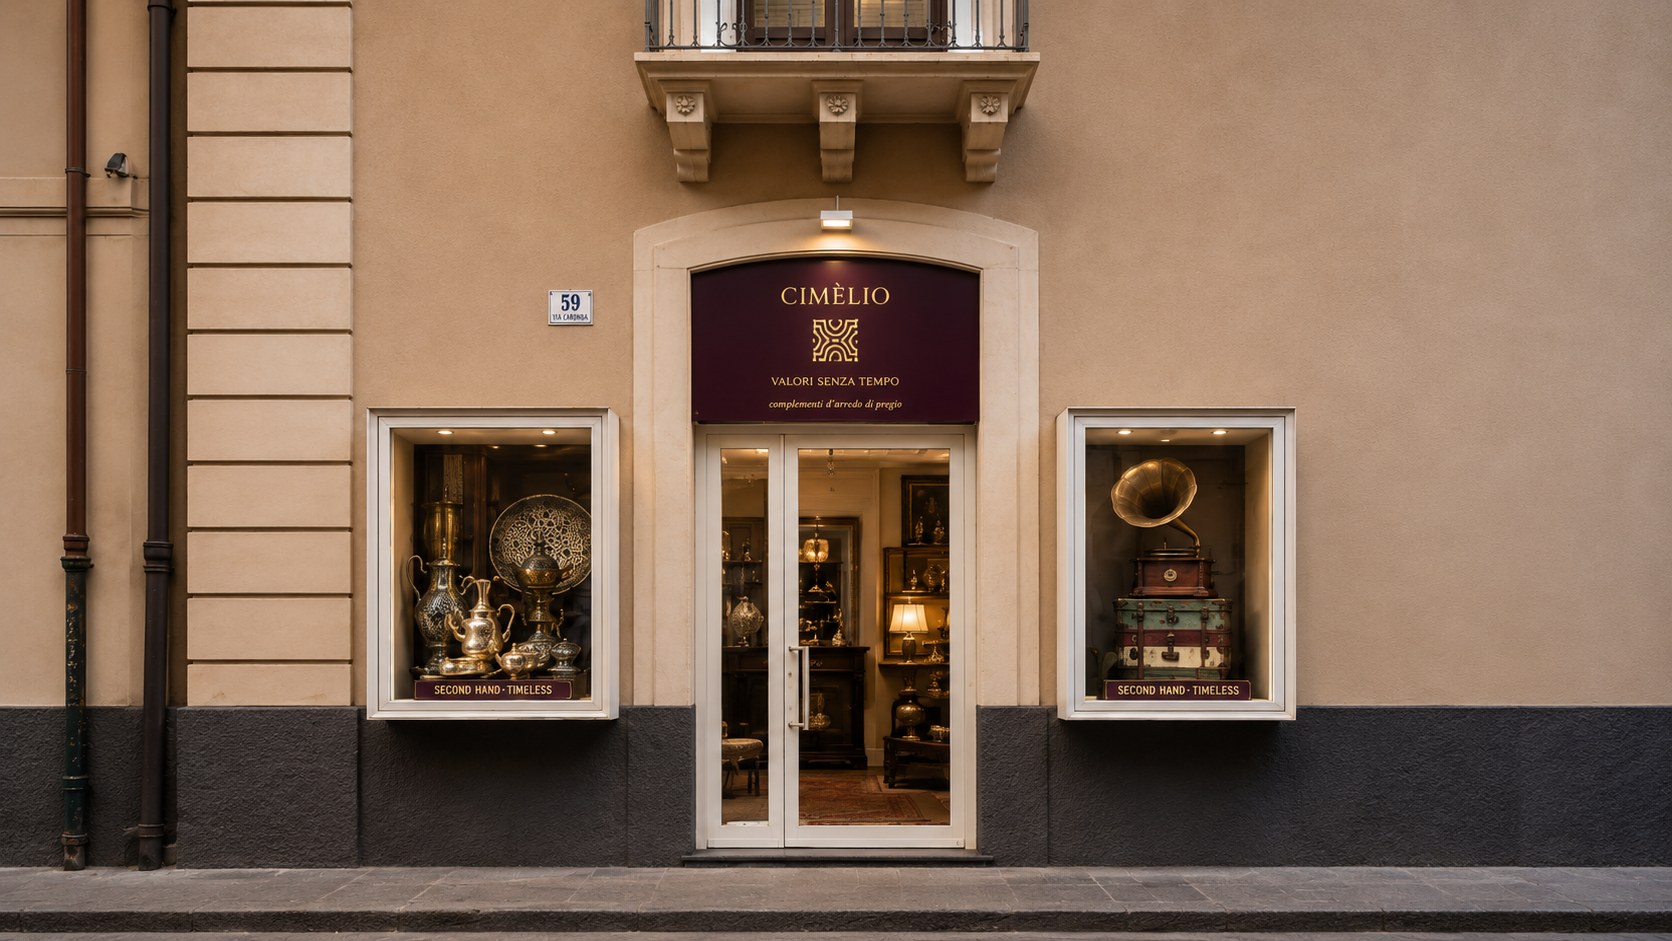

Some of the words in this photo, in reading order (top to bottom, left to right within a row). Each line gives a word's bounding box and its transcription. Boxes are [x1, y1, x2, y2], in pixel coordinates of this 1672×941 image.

[781, 282, 890, 305] CIMÈLIO
[561, 293, 581, 312] 59
[771, 376, 813, 387] VALORI
[817, 376, 856, 387] SENZA
[858, 376, 900, 387] TEMPO
[768, 399, 824, 411] complementi
[864, 399, 874, 409] di
[874, 399, 903, 411] pregio
[434, 684, 472, 696] SECOND
[475, 684, 501, 696] HAND
[506, 684, 553, 696] TIMELESS
[1117, 685, 1156, 696] SECOND
[1159, 685, 1186, 696] HAND
[1192, 685, 1240, 696] TIMELESS
